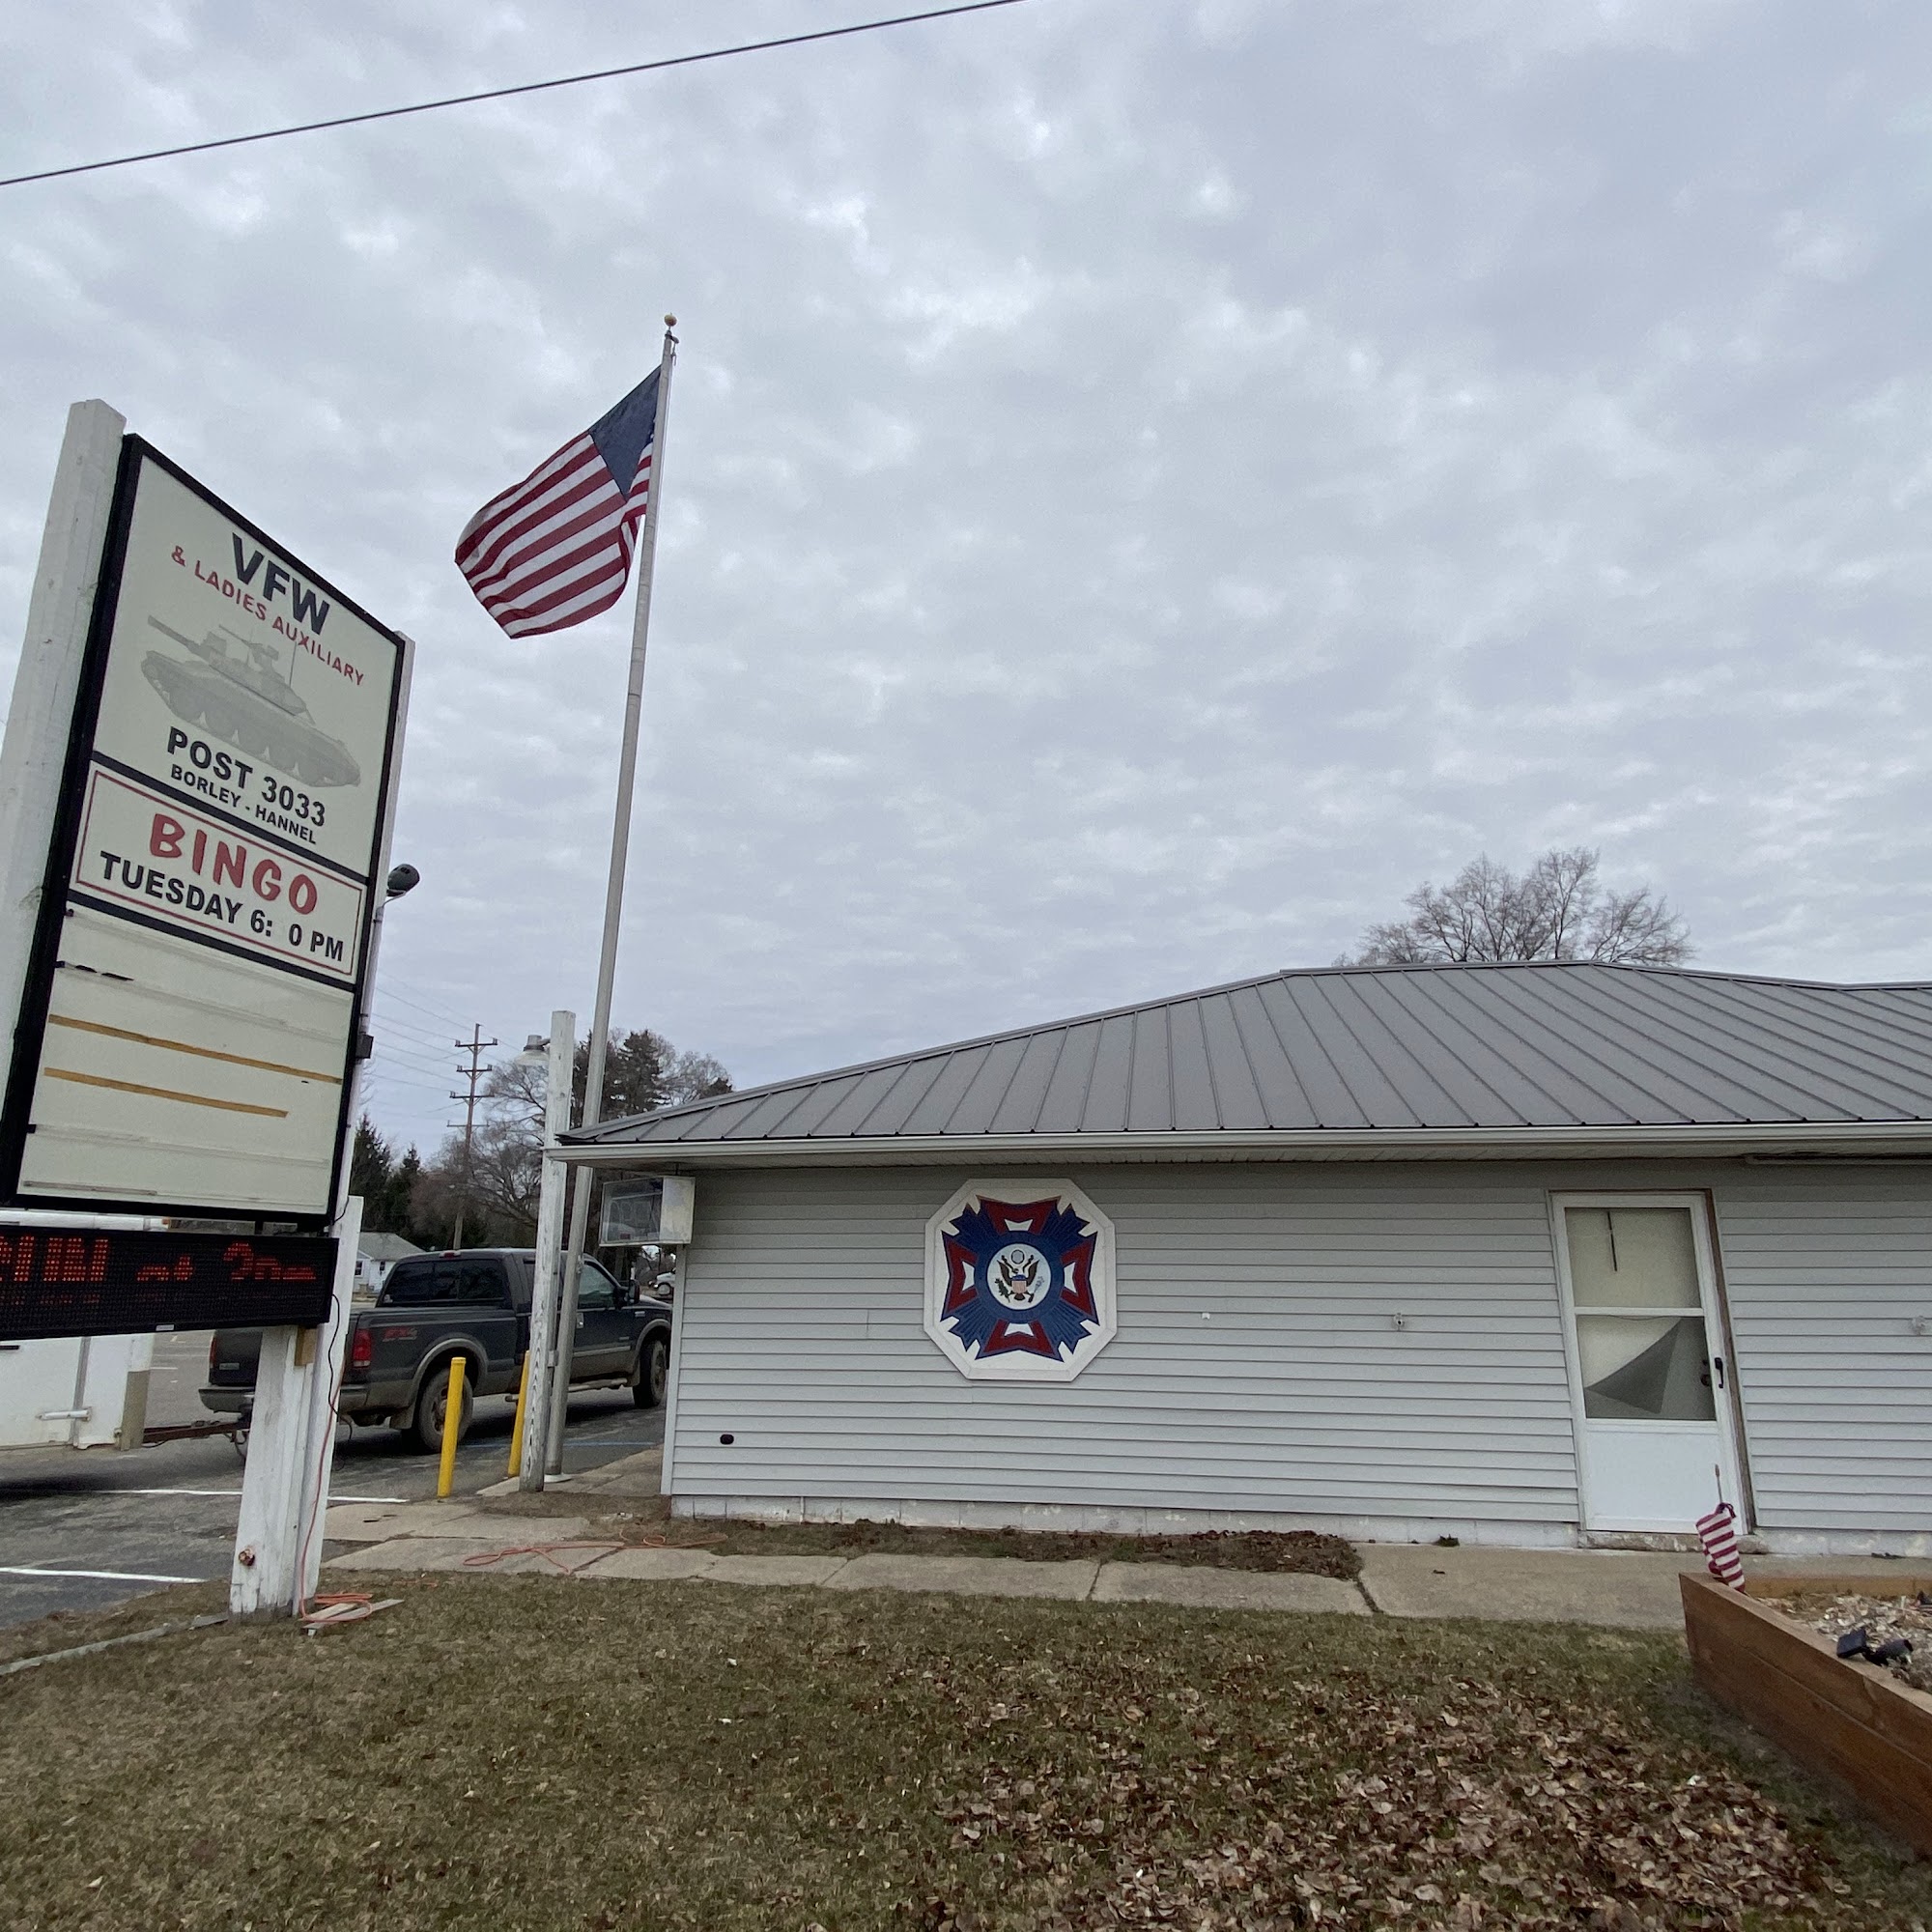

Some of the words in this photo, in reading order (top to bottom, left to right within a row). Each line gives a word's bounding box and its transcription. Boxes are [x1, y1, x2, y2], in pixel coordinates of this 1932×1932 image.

[171, 546, 186, 566] &
[194, 560, 267, 621] LADIES
[271, 615, 364, 686] AUXILIARY
[232, 531, 330, 636] VFW
[167, 726, 253, 789] POST
[261, 776, 326, 827] 3033
[170, 763, 242, 809] BORLEY
[255, 804, 317, 845] HANNEL
[99, 851, 243, 924] TUESDAY
[309, 930, 344, 962] PM
[150, 813, 318, 915] BINGO
